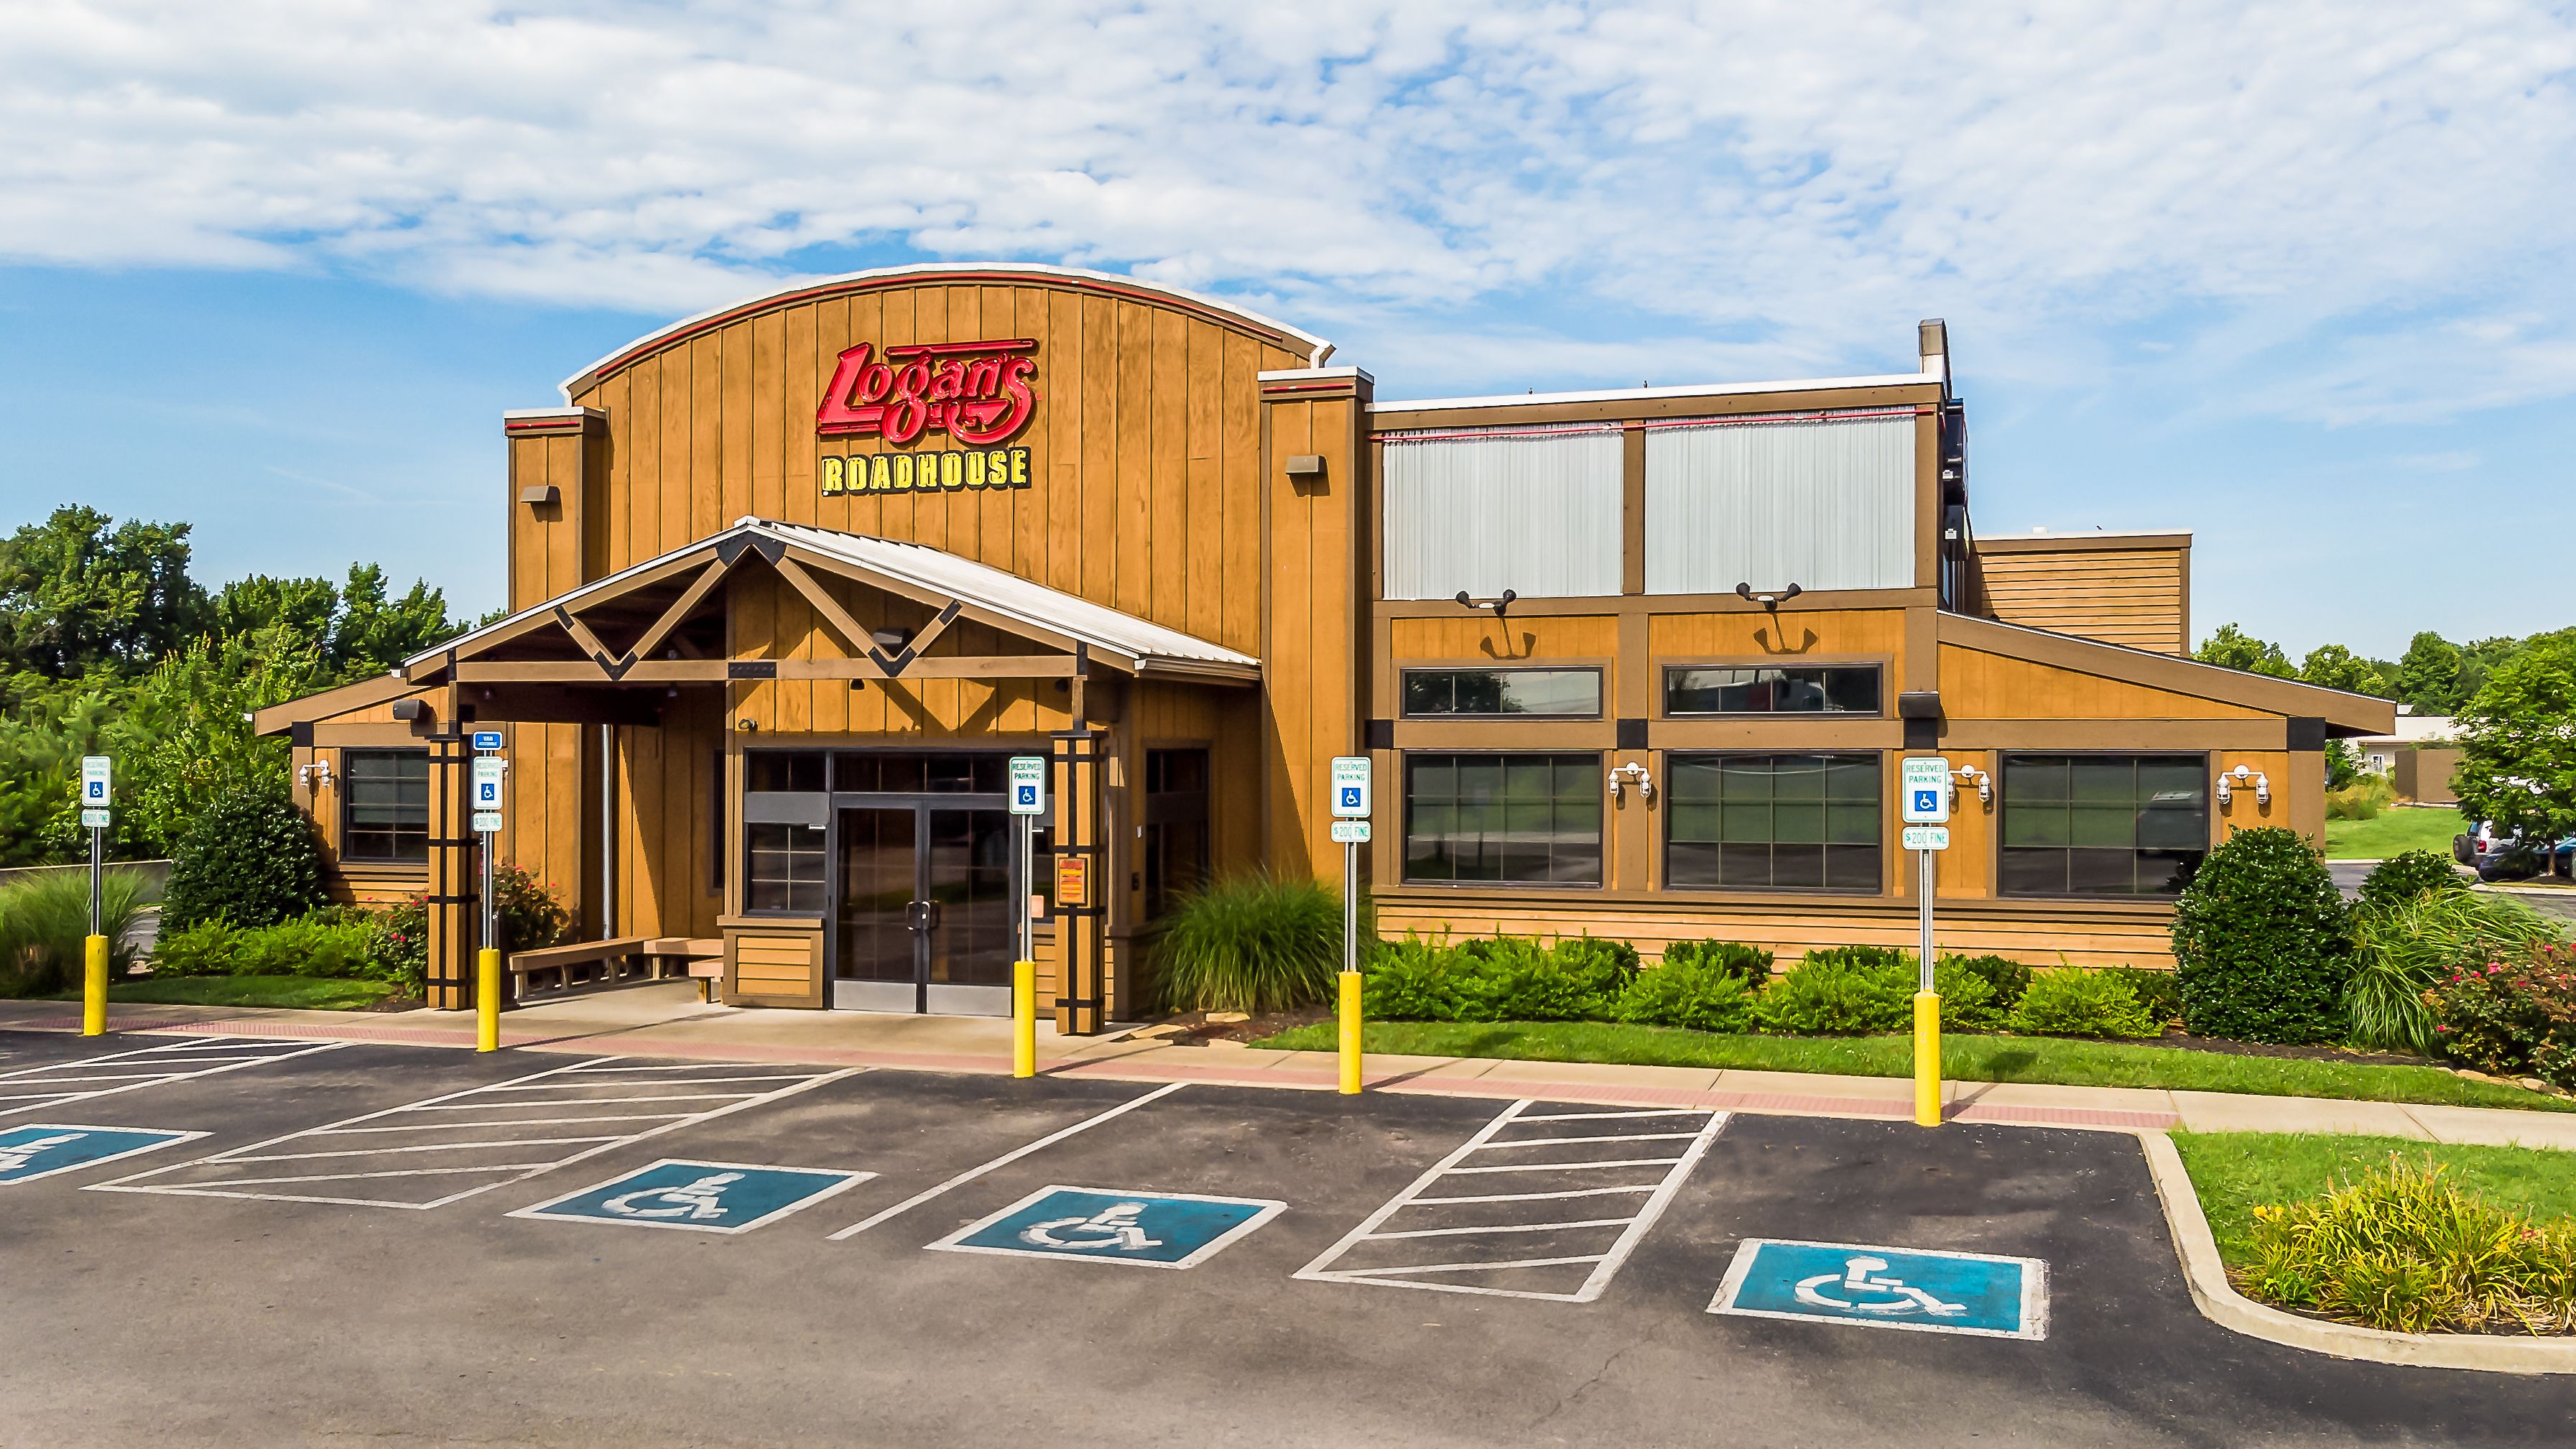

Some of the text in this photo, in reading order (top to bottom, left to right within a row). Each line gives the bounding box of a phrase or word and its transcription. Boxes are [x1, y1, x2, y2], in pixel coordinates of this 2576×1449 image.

[822, 450, 1027, 491] ROADHOUSE
[1906, 764, 1944, 773] RESERVED
[1355, 826, 1368, 837] FINE
[1930, 833, 1947, 844] FINE
